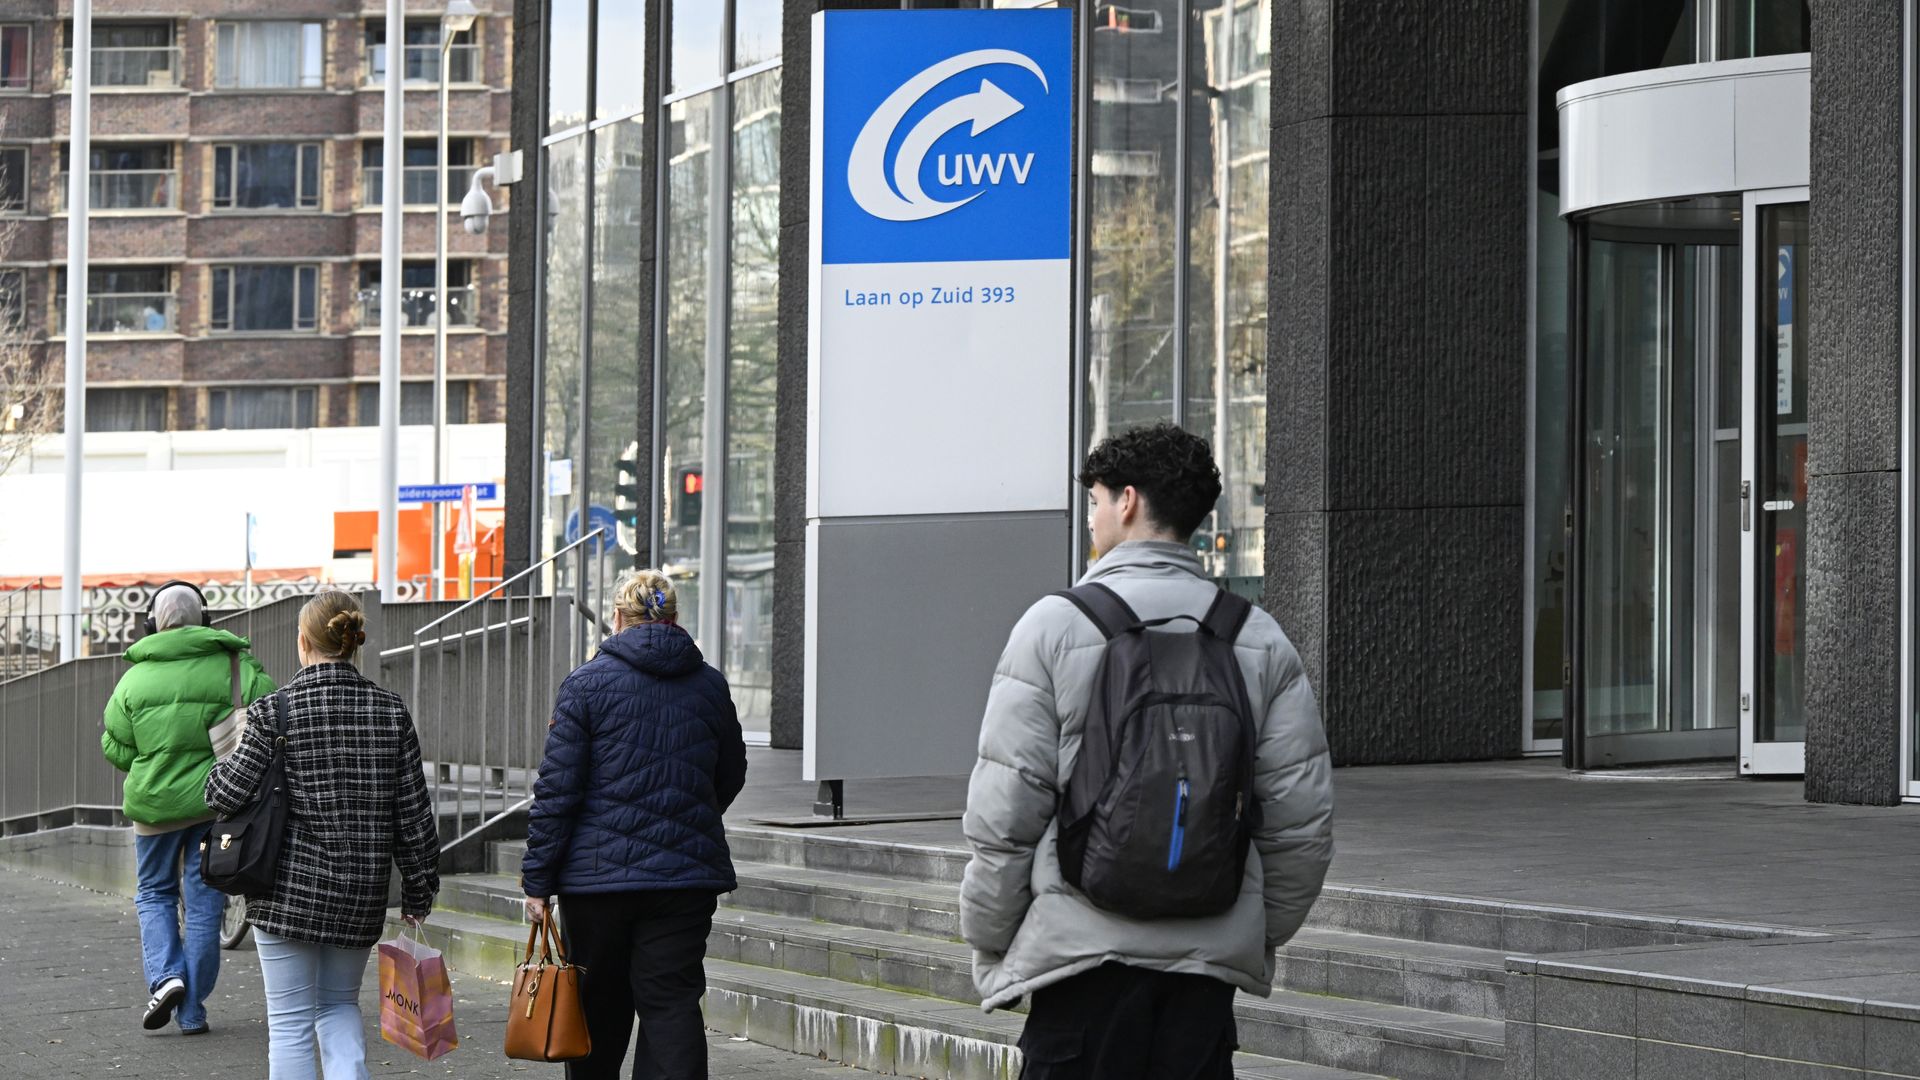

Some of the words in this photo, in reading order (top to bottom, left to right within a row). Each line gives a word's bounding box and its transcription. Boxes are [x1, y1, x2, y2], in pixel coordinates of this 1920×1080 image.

[845, 289, 891, 306] Laan
[899, 291, 924, 308] op
[931, 286, 973, 304] Zuid
[981, 286, 1015, 304] 393
